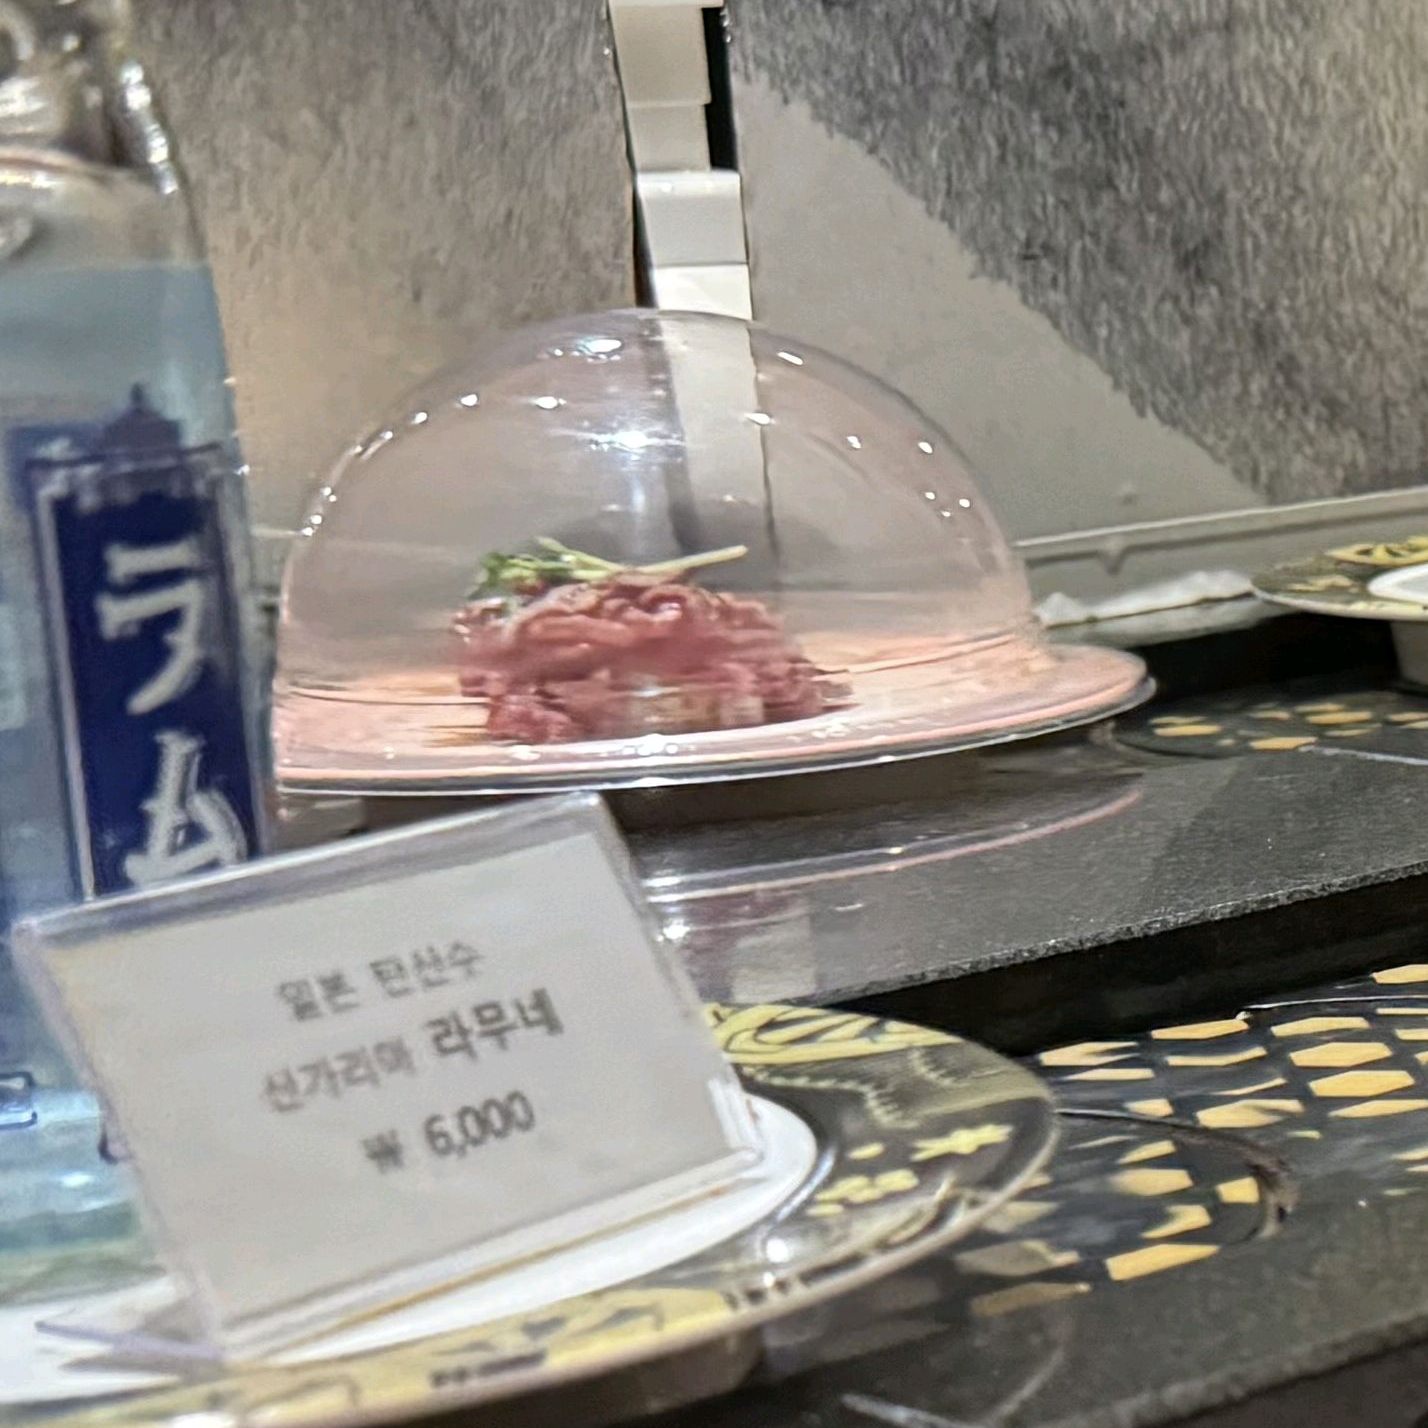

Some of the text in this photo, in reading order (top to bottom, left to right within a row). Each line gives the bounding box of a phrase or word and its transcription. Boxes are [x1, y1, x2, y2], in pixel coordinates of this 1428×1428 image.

[277, 941, 484, 1022] 일본 탄산수
[425, 987, 564, 1061] 라무네
[424, 1090, 536, 1159] 6,000
